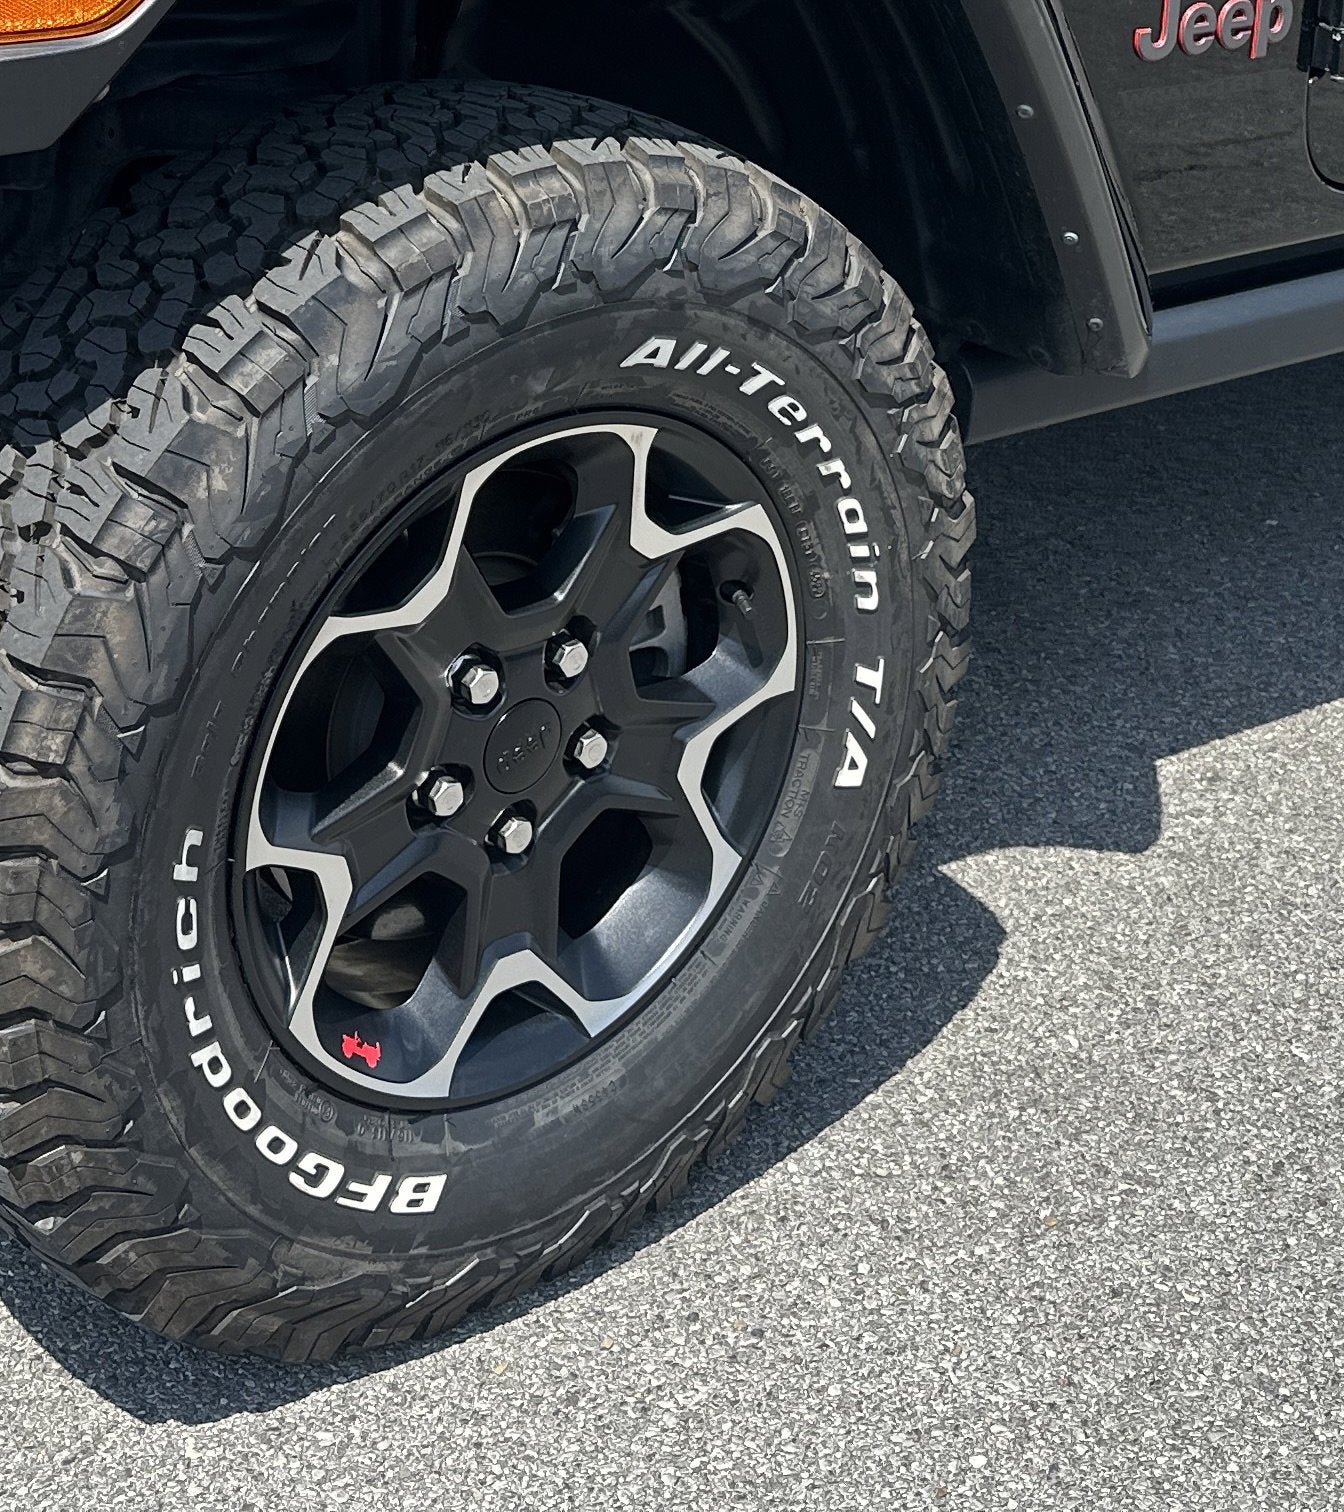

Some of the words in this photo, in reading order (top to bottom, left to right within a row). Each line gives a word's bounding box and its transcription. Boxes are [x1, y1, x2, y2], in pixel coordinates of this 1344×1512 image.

[618, 335, 880, 612] All-Terrain
[833, 654, 885, 788] T/A
[780, 752, 810, 819] TRACTION
[172, 827, 449, 1215] BFGoodrich
